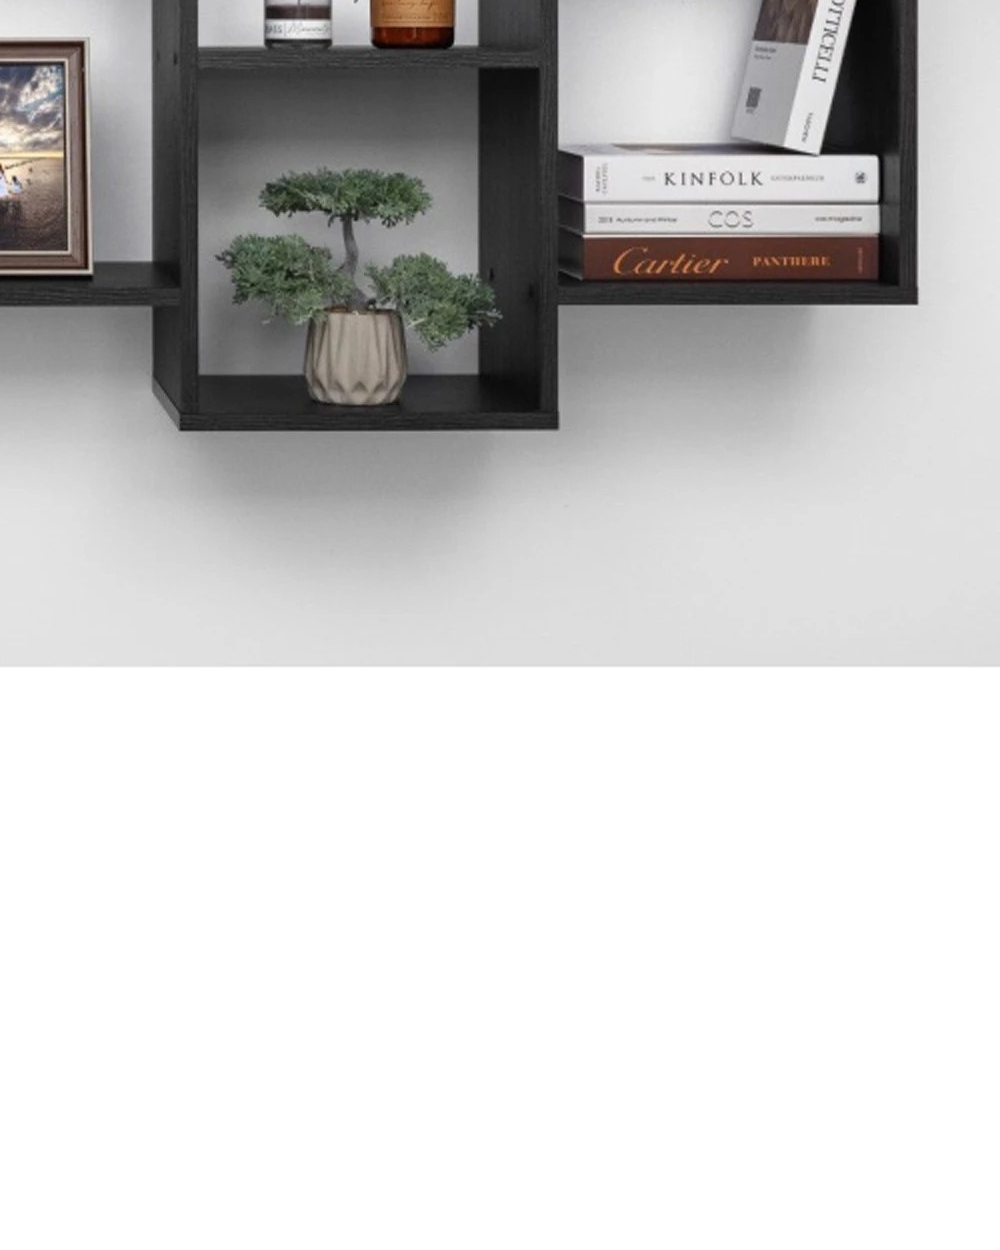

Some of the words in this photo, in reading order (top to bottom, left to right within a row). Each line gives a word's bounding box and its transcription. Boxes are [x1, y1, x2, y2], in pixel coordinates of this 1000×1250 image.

[664, 171, 764, 186] KINFOLK
[707, 210, 755, 229] COS
[613, 247, 729, 276] Cartier
